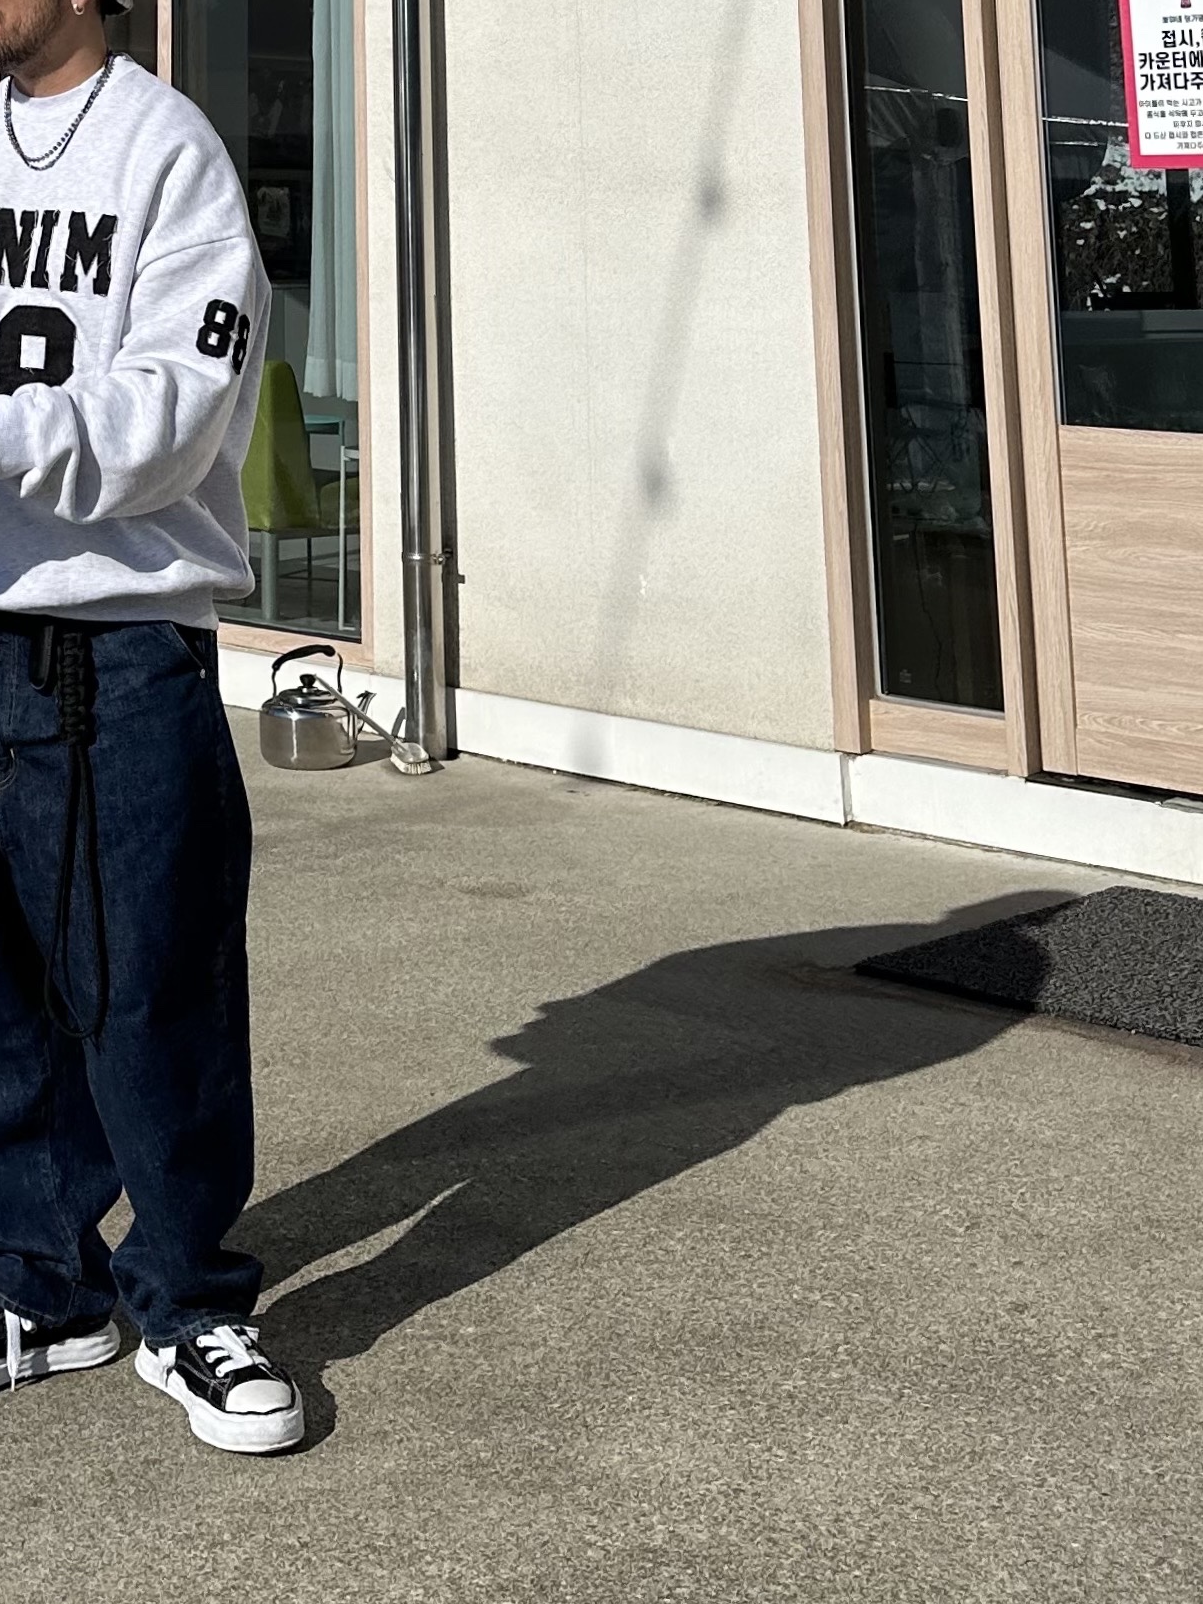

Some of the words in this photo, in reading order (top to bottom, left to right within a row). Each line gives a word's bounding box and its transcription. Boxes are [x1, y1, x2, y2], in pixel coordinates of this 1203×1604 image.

[1161, 28, 1203, 48] 접시,
[1138, 49, 1203, 70] 카운터에
[195, 298, 251, 375] 88
